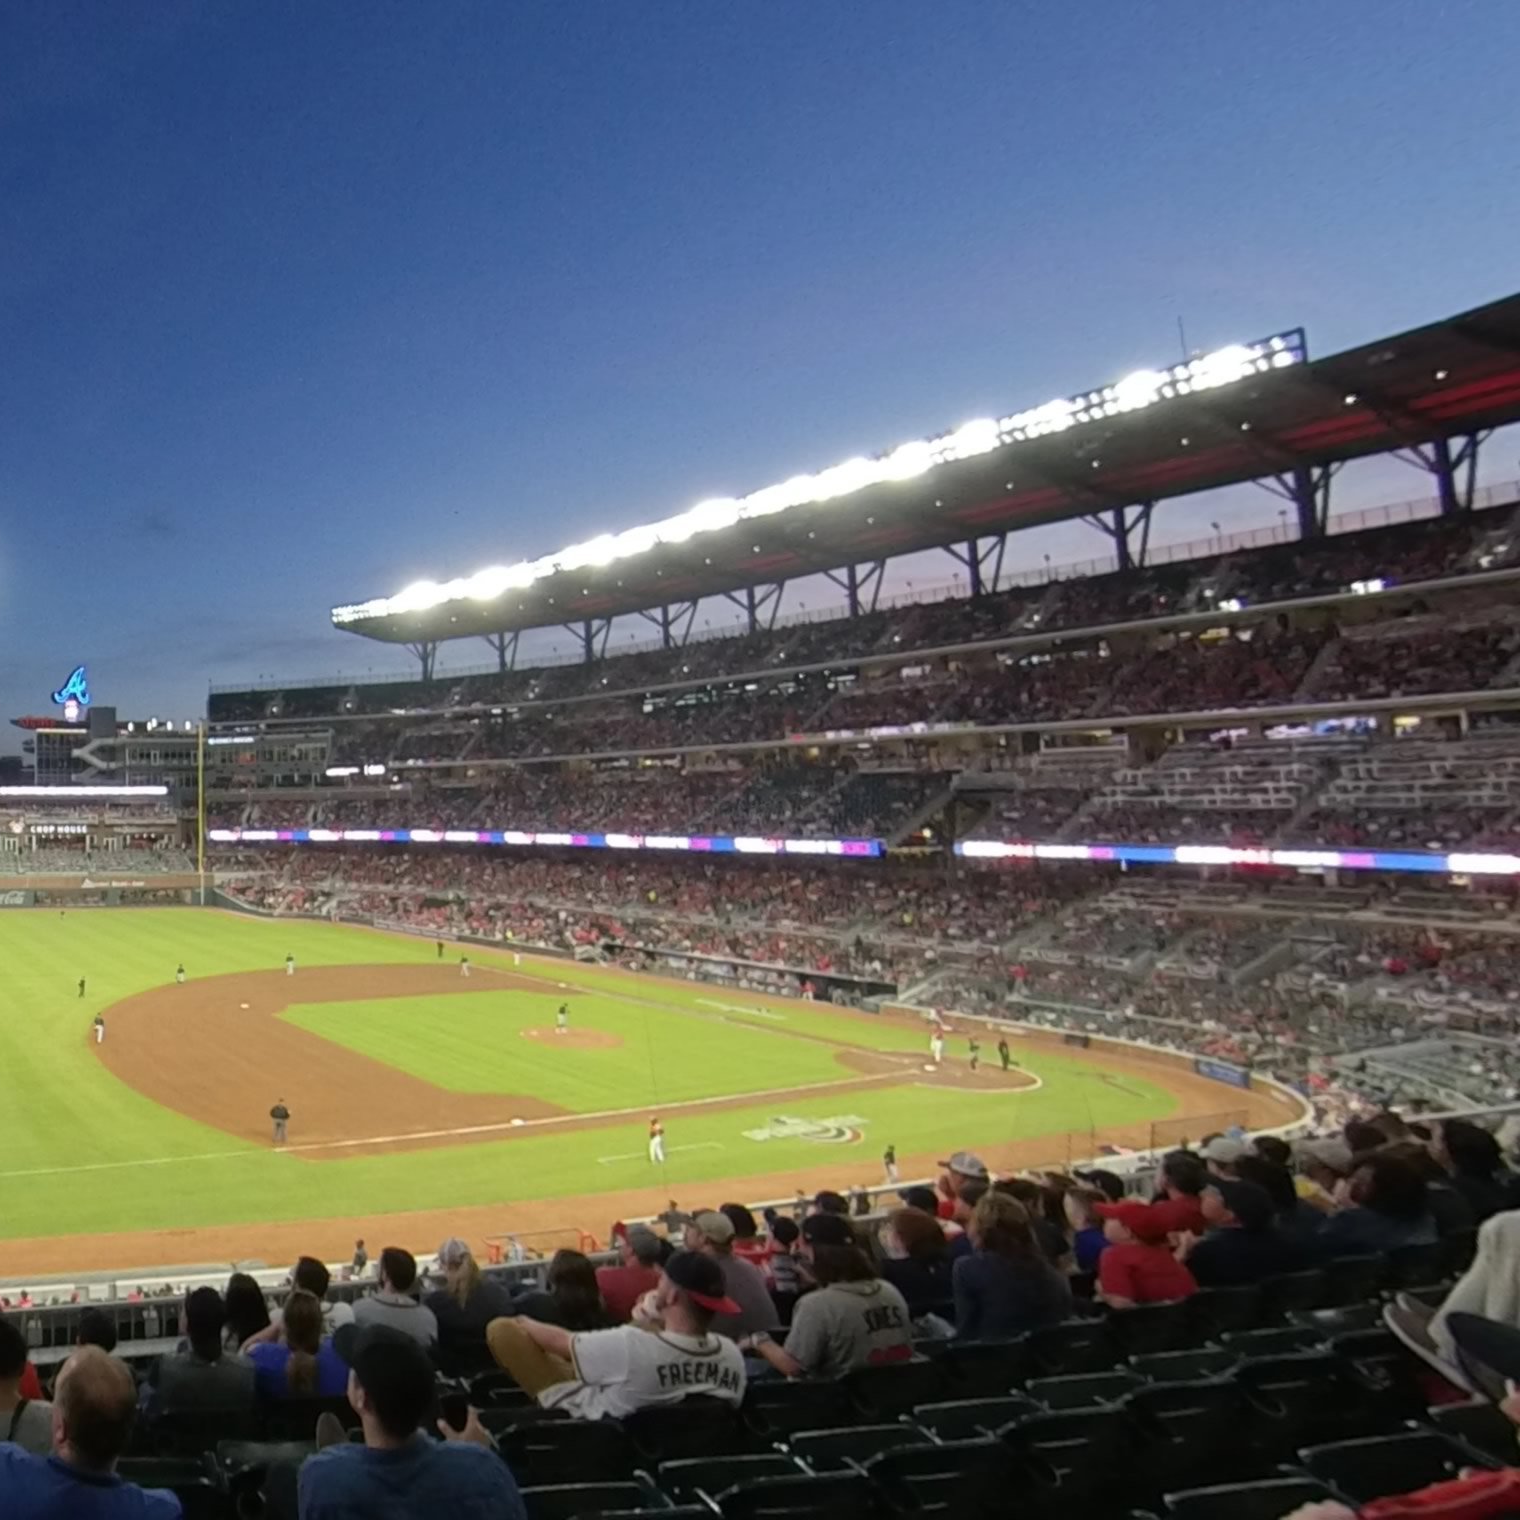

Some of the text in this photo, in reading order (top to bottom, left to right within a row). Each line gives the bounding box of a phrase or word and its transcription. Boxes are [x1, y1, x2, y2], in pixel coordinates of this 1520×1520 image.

[30, 825, 88, 834] CHOP HOUSE
[656, 1362, 741, 1394] FREEMAN
